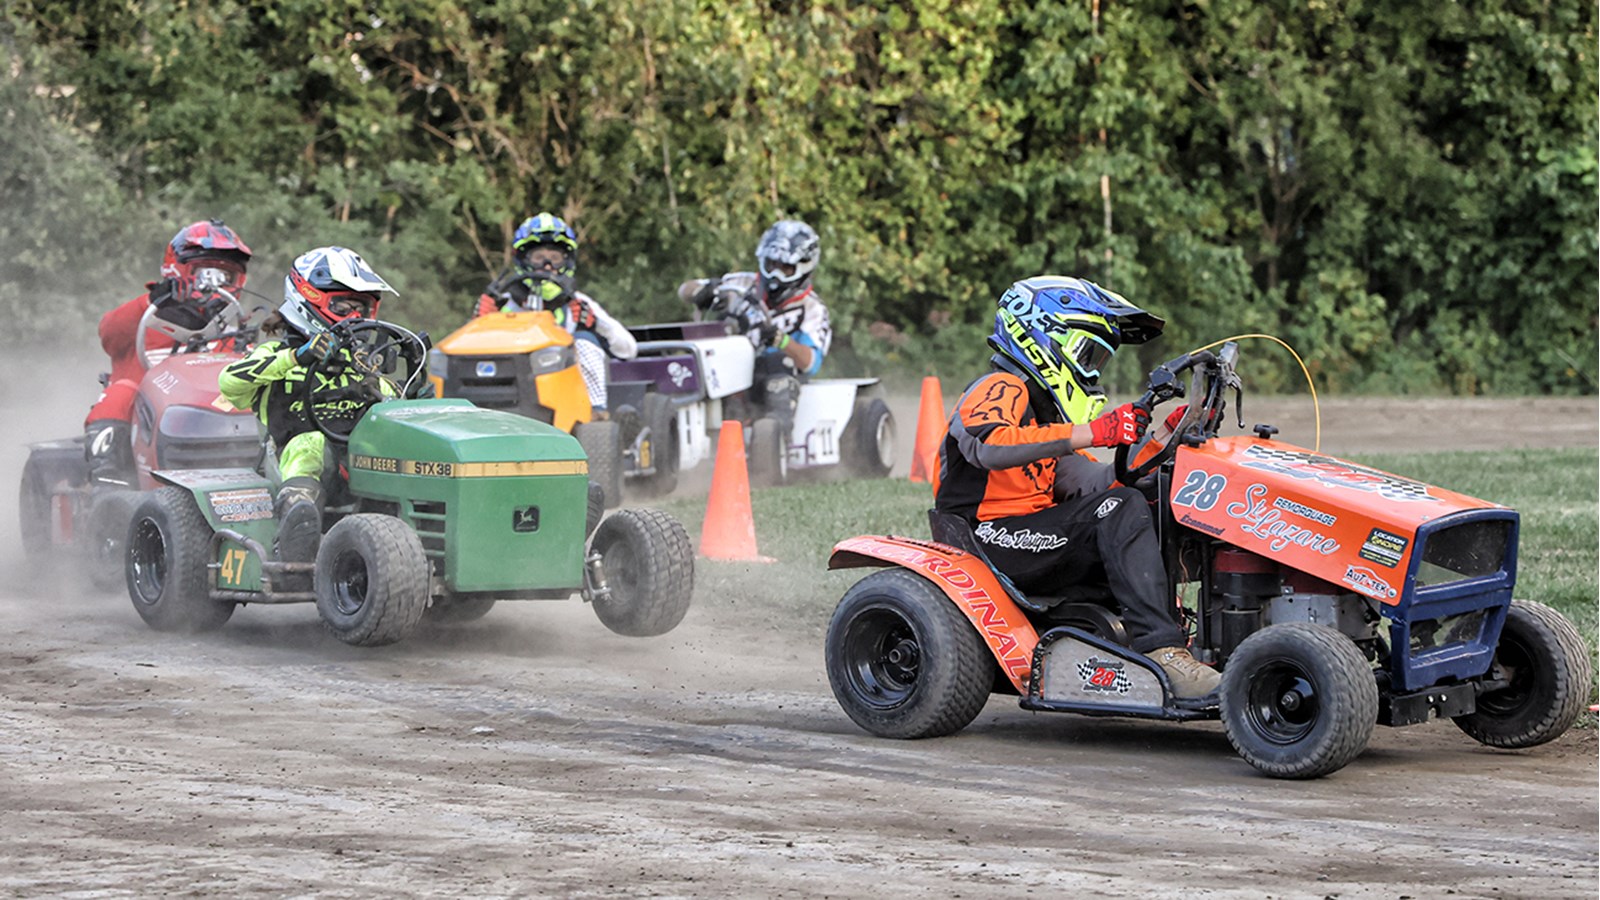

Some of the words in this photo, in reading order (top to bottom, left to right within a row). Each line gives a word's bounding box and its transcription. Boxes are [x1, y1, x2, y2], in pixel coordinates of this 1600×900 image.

[998, 288, 1048, 333] FOX
[1123, 411, 1134, 442] FOX
[372, 457, 397, 472] DEERE
[1173, 469, 1228, 511] 28
[1240, 508, 1341, 555] Lazare
[1373, 530, 1405, 545] LOCATION
[221, 548, 246, 585] 47
[1090, 666, 1116, 687] 28
